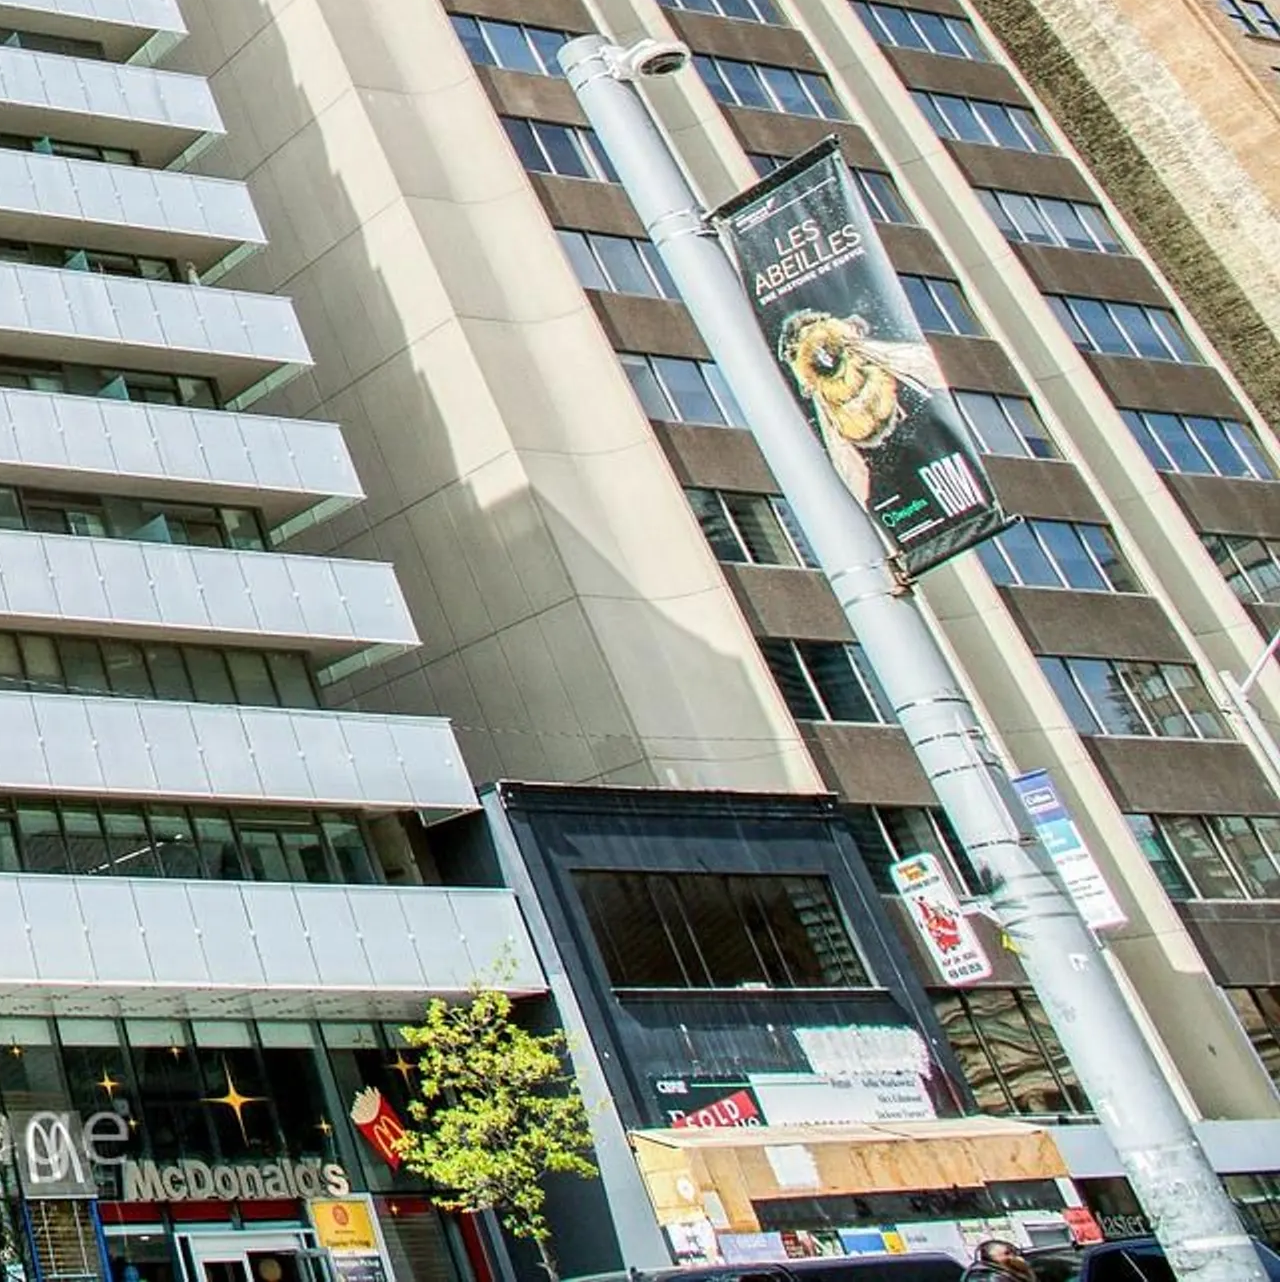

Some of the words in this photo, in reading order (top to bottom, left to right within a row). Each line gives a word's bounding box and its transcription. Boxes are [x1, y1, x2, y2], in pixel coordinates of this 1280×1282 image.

[755, 224, 861, 296] ABEILLES
[774, 220, 820, 256] LES
[918, 451, 986, 518] ROM
[124, 1157, 350, 1201] McDonald's
